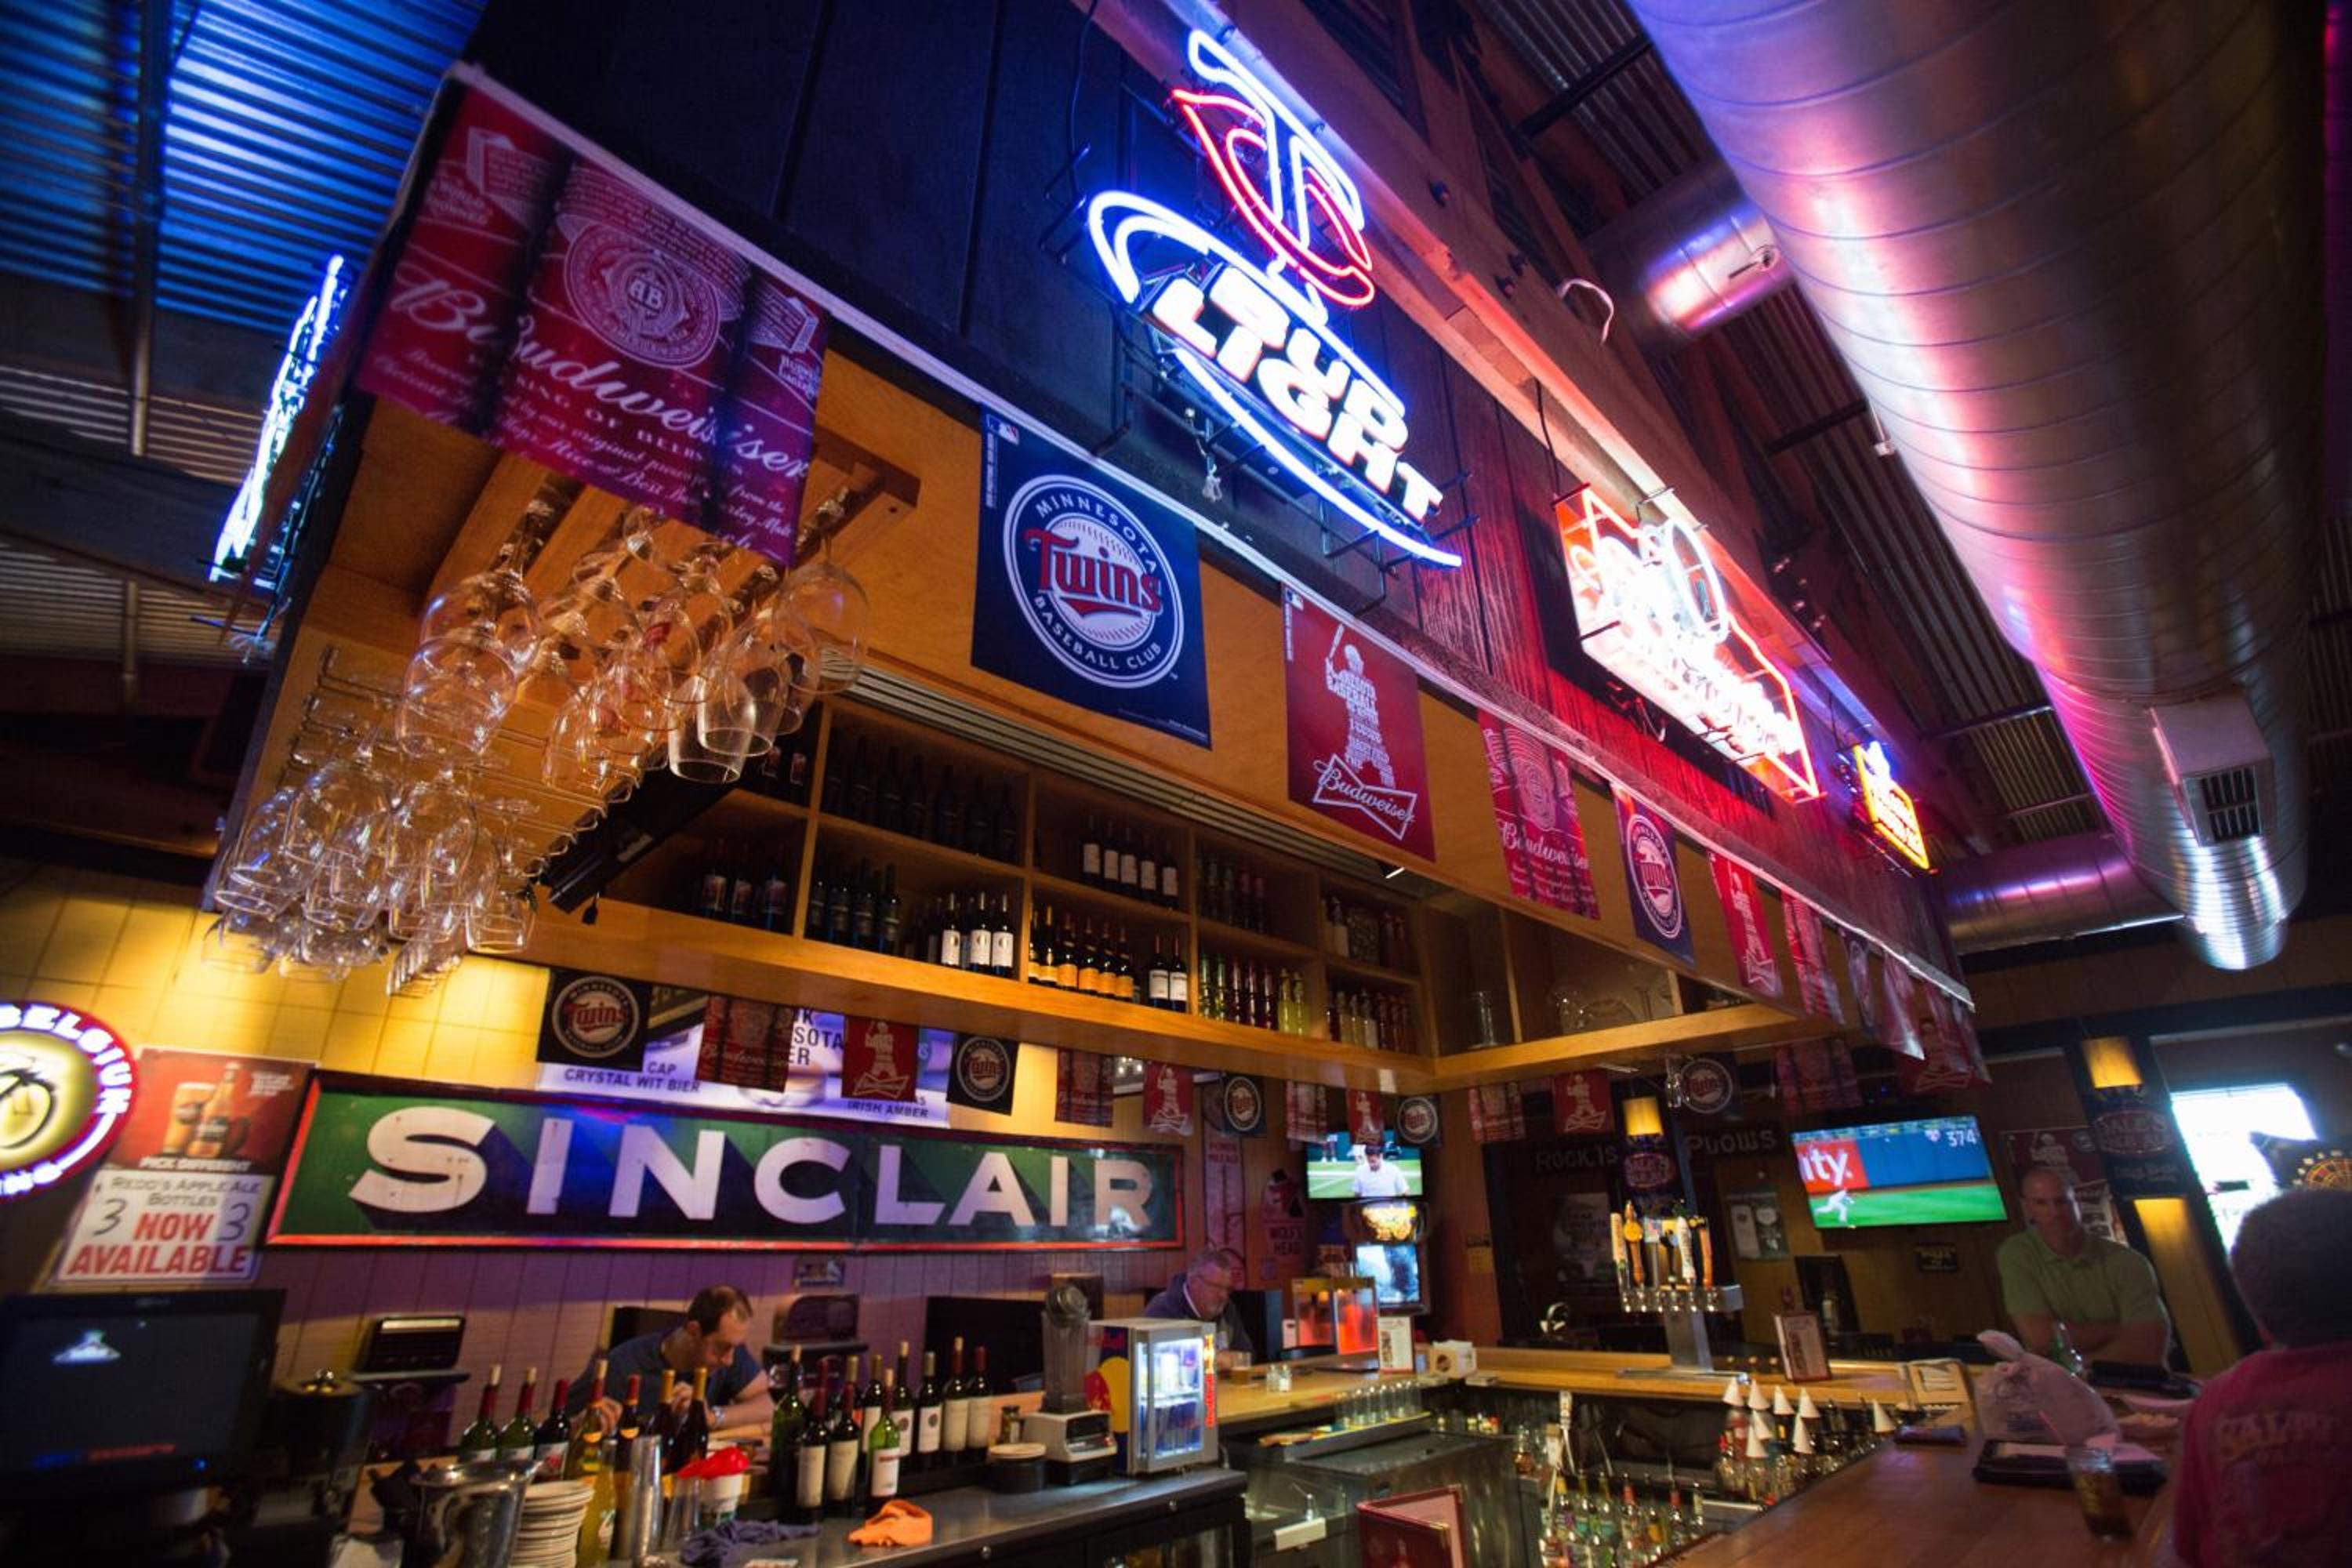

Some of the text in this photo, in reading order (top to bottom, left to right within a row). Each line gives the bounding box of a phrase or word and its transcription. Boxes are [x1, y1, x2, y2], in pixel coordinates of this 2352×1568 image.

[1208, 264, 1410, 453] BUD
[1151, 277, 1443, 528] LIGHT
[1035, 492, 1158, 573] MINNESOTA
[1023, 528, 1163, 615] Twins
[1033, 595, 1162, 670] BASEBALL CLUB
[1314, 759, 1414, 824] Budweiser
[793, 1026, 844, 1051] SOTA
[563, 1068, 701, 1093] CRYSTAL WIT BIER
[647, 1061, 677, 1075] CAP
[847, 1100, 930, 1119] IRISH AMBER
[1945, 1129, 1977, 1148] 374
[348, 1105, 1152, 1229] SINCLAIR
[1800, 1146, 1853, 1186] ity.
[231, 1180, 263, 1195] ALE
[93, 1198, 129, 1236] 3
[132, 1211, 216, 1242] NOW
[217, 1202, 251, 1242] 3
[67, 1245, 249, 1276] AVAILABLE
